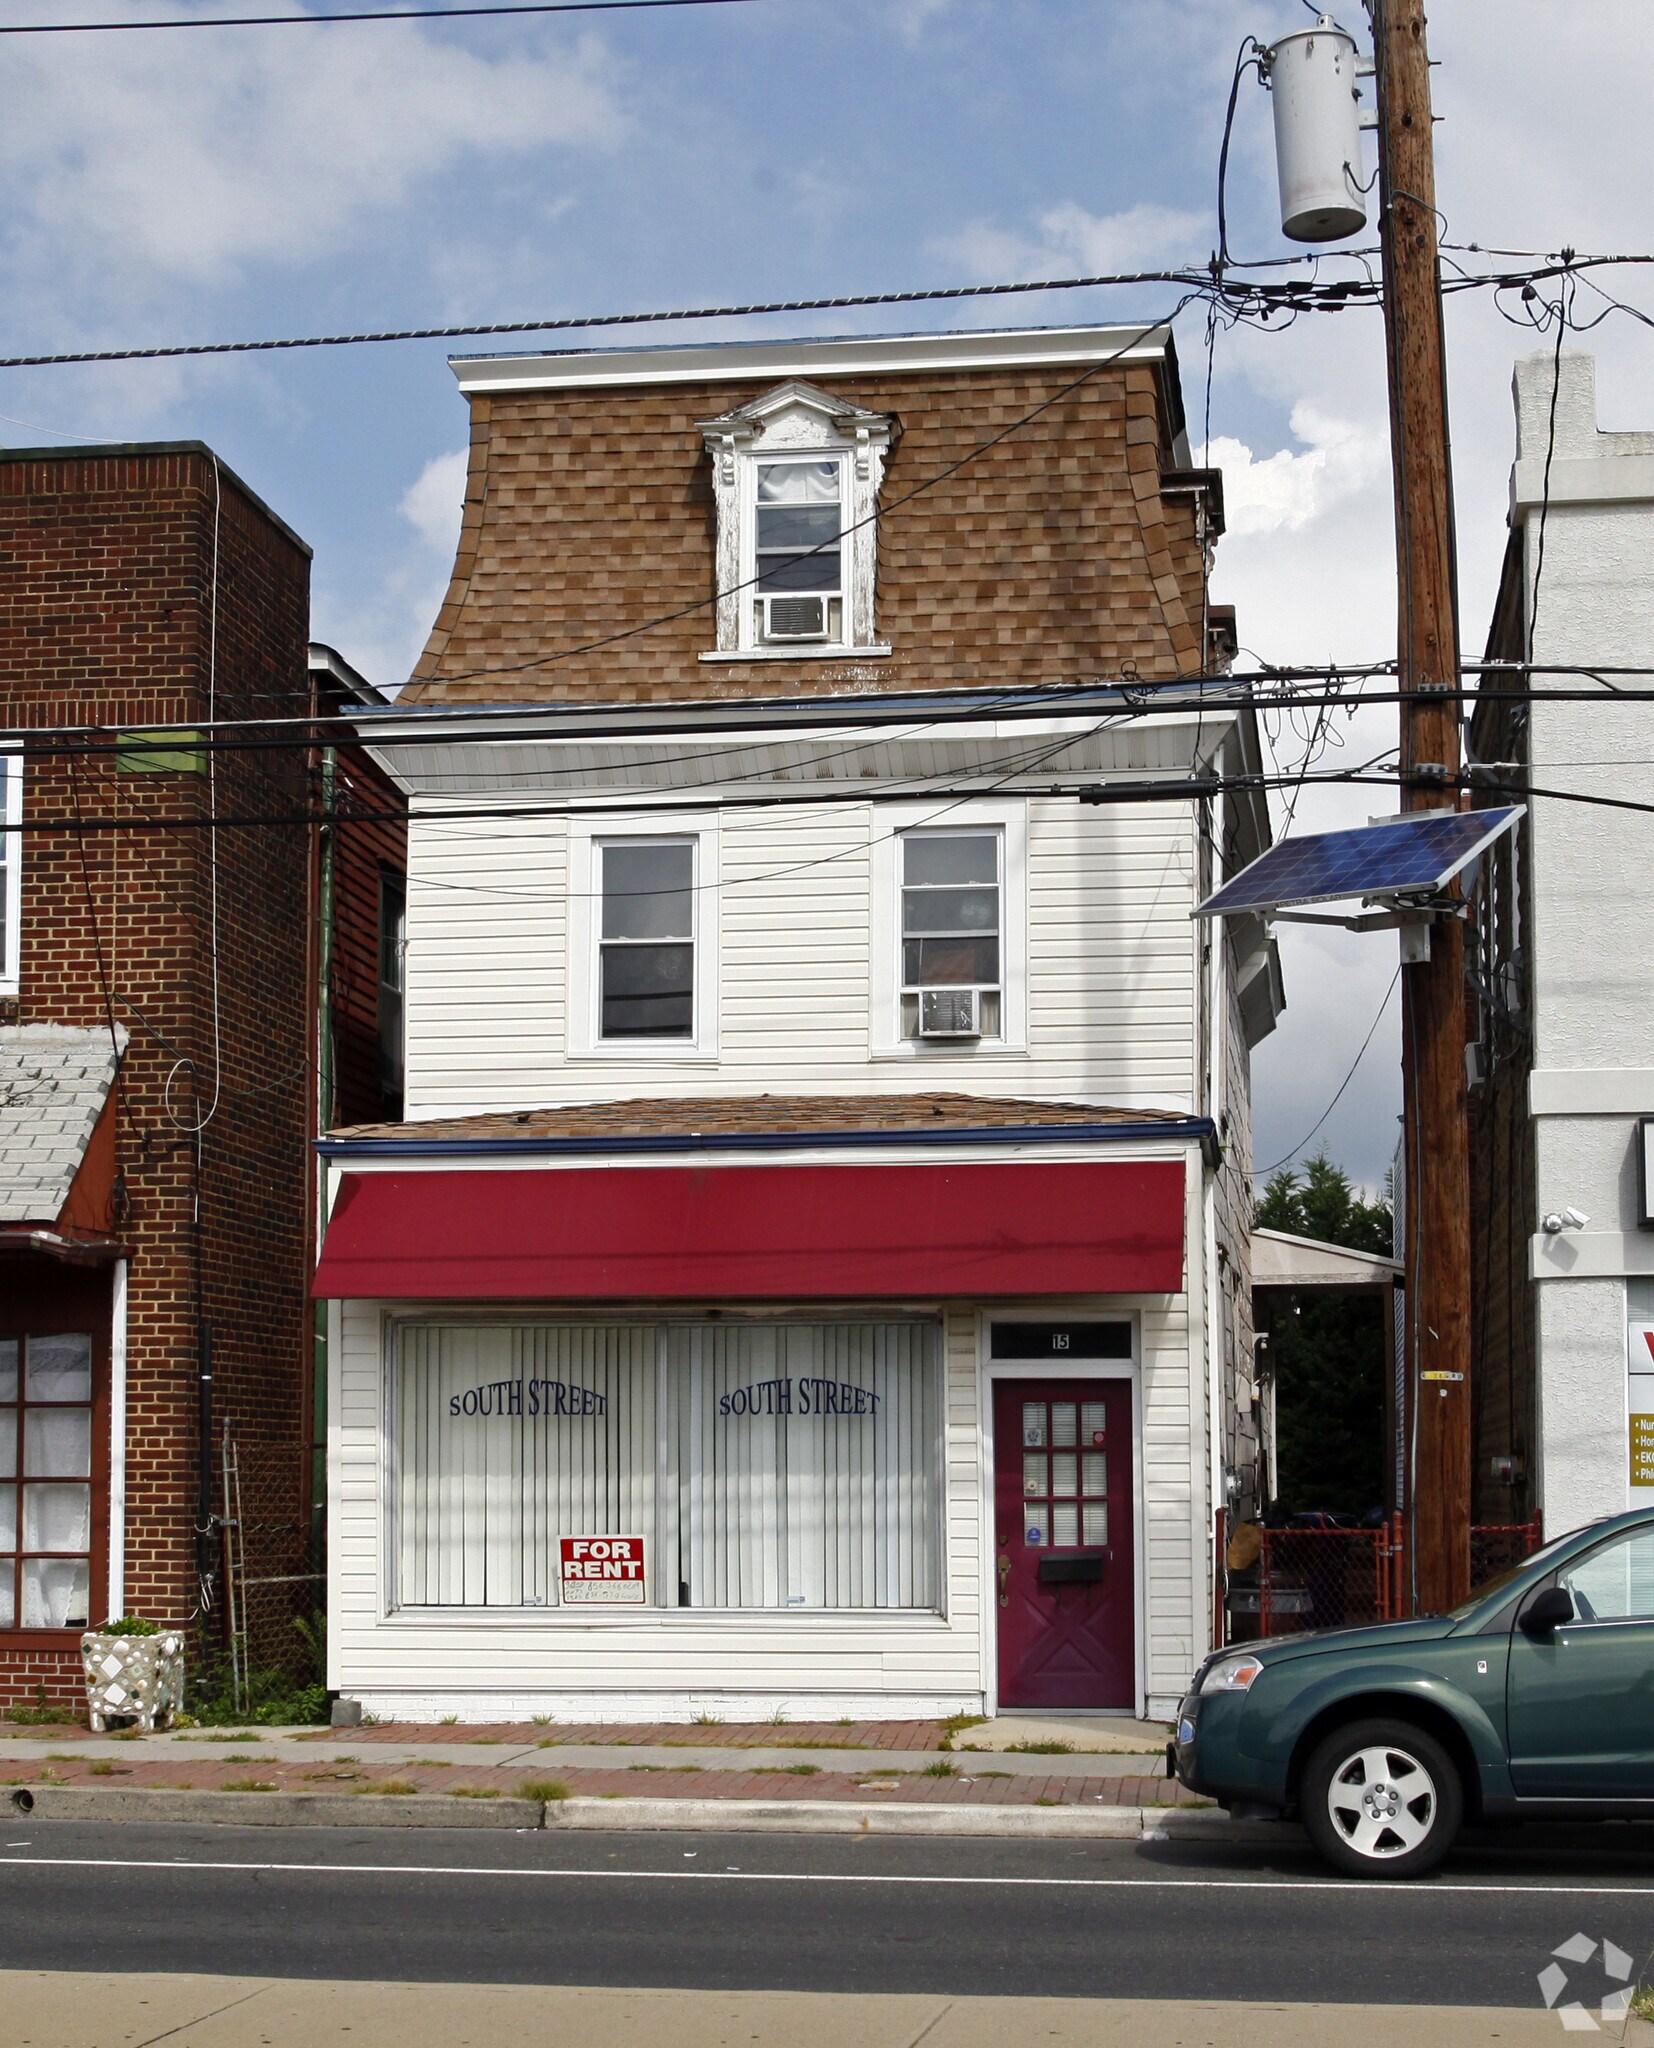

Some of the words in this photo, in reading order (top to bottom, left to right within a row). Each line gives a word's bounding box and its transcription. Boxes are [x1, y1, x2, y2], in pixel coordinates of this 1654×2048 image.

[1053, 1334, 1068, 1349] 15
[450, 1380, 523, 1416] SOUTH
[528, 1378, 608, 1416] STREET
[719, 1378, 793, 1416] SOUTH
[799, 1377, 880, 1415] STREET
[572, 1541, 631, 1559] FOR
[564, 1560, 641, 1578] RENT
